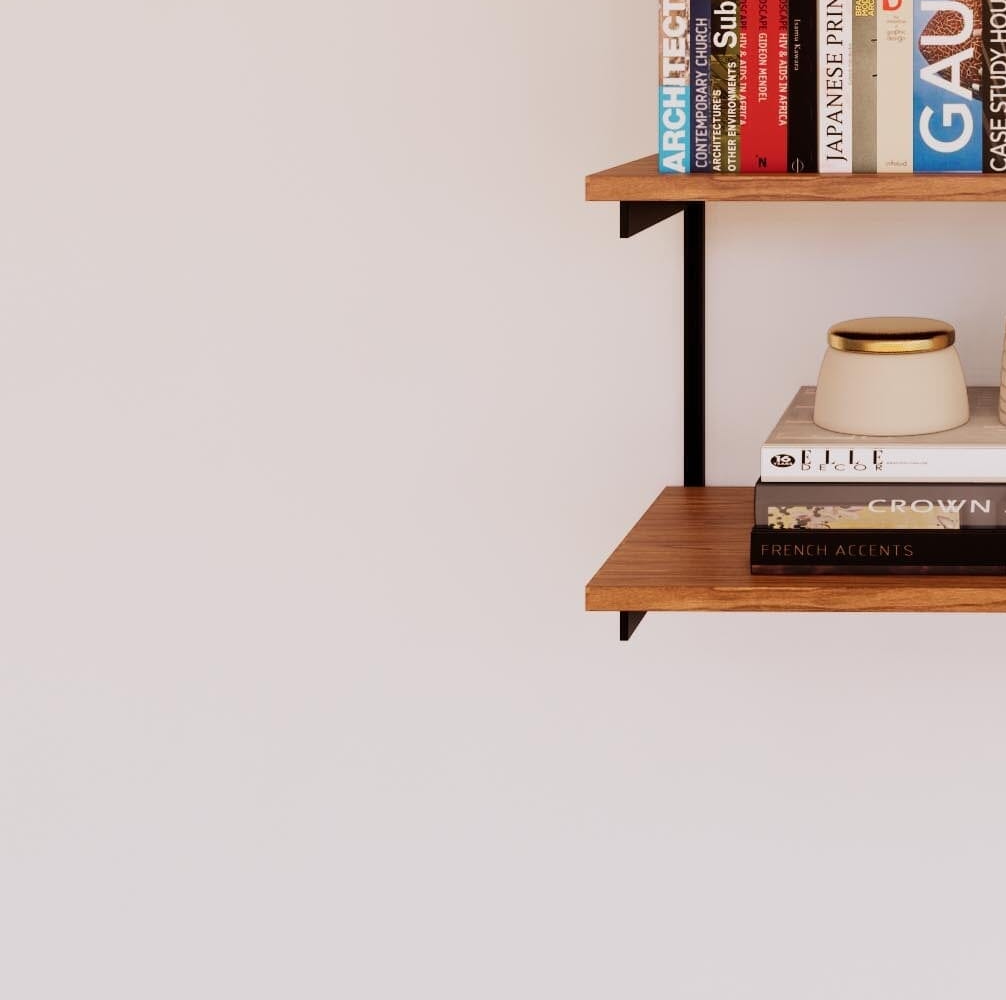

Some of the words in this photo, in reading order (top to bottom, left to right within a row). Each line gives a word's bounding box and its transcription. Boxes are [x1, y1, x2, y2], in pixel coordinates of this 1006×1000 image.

[695, 18, 708, 67] CHURCH
[759, 32, 768, 66] GIDEON
[779, 32, 787, 49] HIV
[779, 50, 787, 58] &
[779, 59, 787, 81] AIDS
[793, 44, 801, 71] Kawara
[727, 61, 737, 136] ENVIRONMENTS
[759, 68, 768, 102] MENDEL
[779, 82, 787, 92] IN
[695, 72, 708, 168] CONTEMPORARY
[779, 94, 787, 126] AFRICA
[827, 52, 846, 162] JAPANESE
[712, 89, 722, 171] ARCHITECTURE'S
[727, 139, 737, 172] OTHER
[801, 450, 882, 464] ELLE
[867, 499, 991, 513] CROWN
[761, 543, 827, 557] FRENCH
[835, 543, 914, 557] ACCENTS
